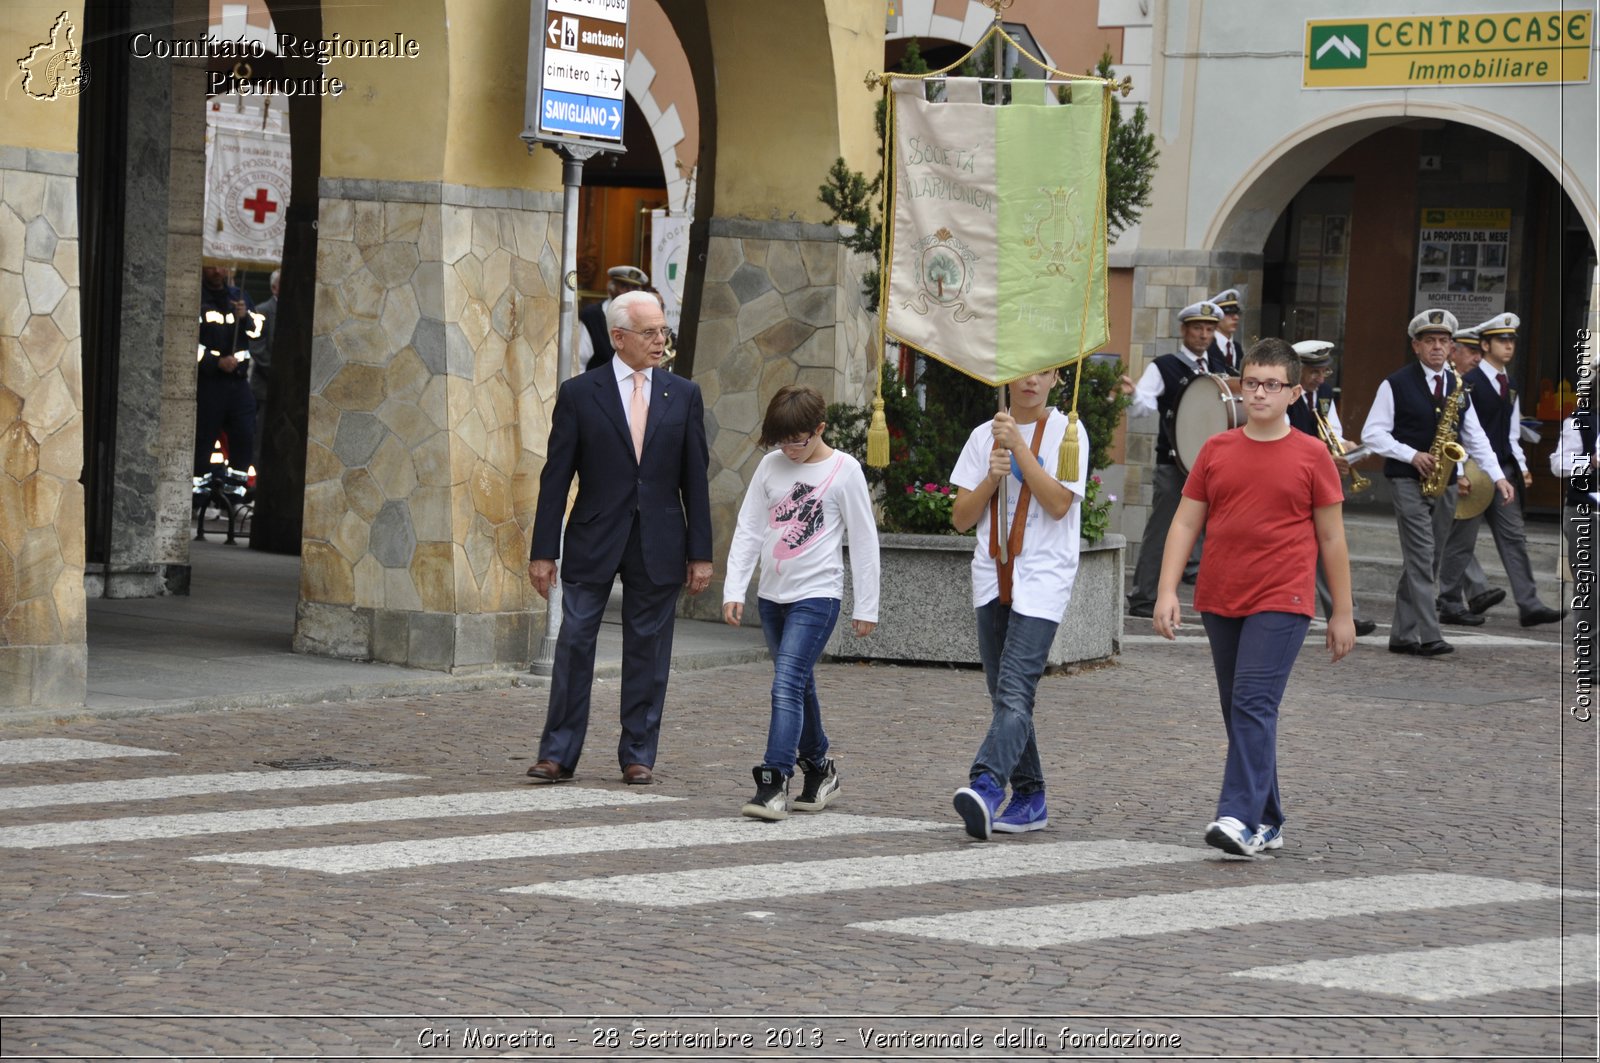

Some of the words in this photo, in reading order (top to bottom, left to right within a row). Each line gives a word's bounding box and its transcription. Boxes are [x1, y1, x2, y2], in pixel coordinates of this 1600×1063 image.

[581, 30, 625, 49] santuario
[1375, 14, 1587, 48] CENTROCASE
[547, 62, 590, 82] cimitero
[1408, 57, 1550, 81] Immobiliare
[545, 99, 607, 127] SAVIGLIANO
[242, 158, 278, 171] ROSSA
[1426, 157, 1433, 168] 4
[1422, 231, 1431, 241] LA
[1433, 231, 1471, 241] PROPOSTA
[1473, 231, 1487, 242] DEL
[1489, 231, 1508, 242] MESE
[1428, 293, 1467, 302] MORETTA
[1468, 294, 1493, 303] Centro
